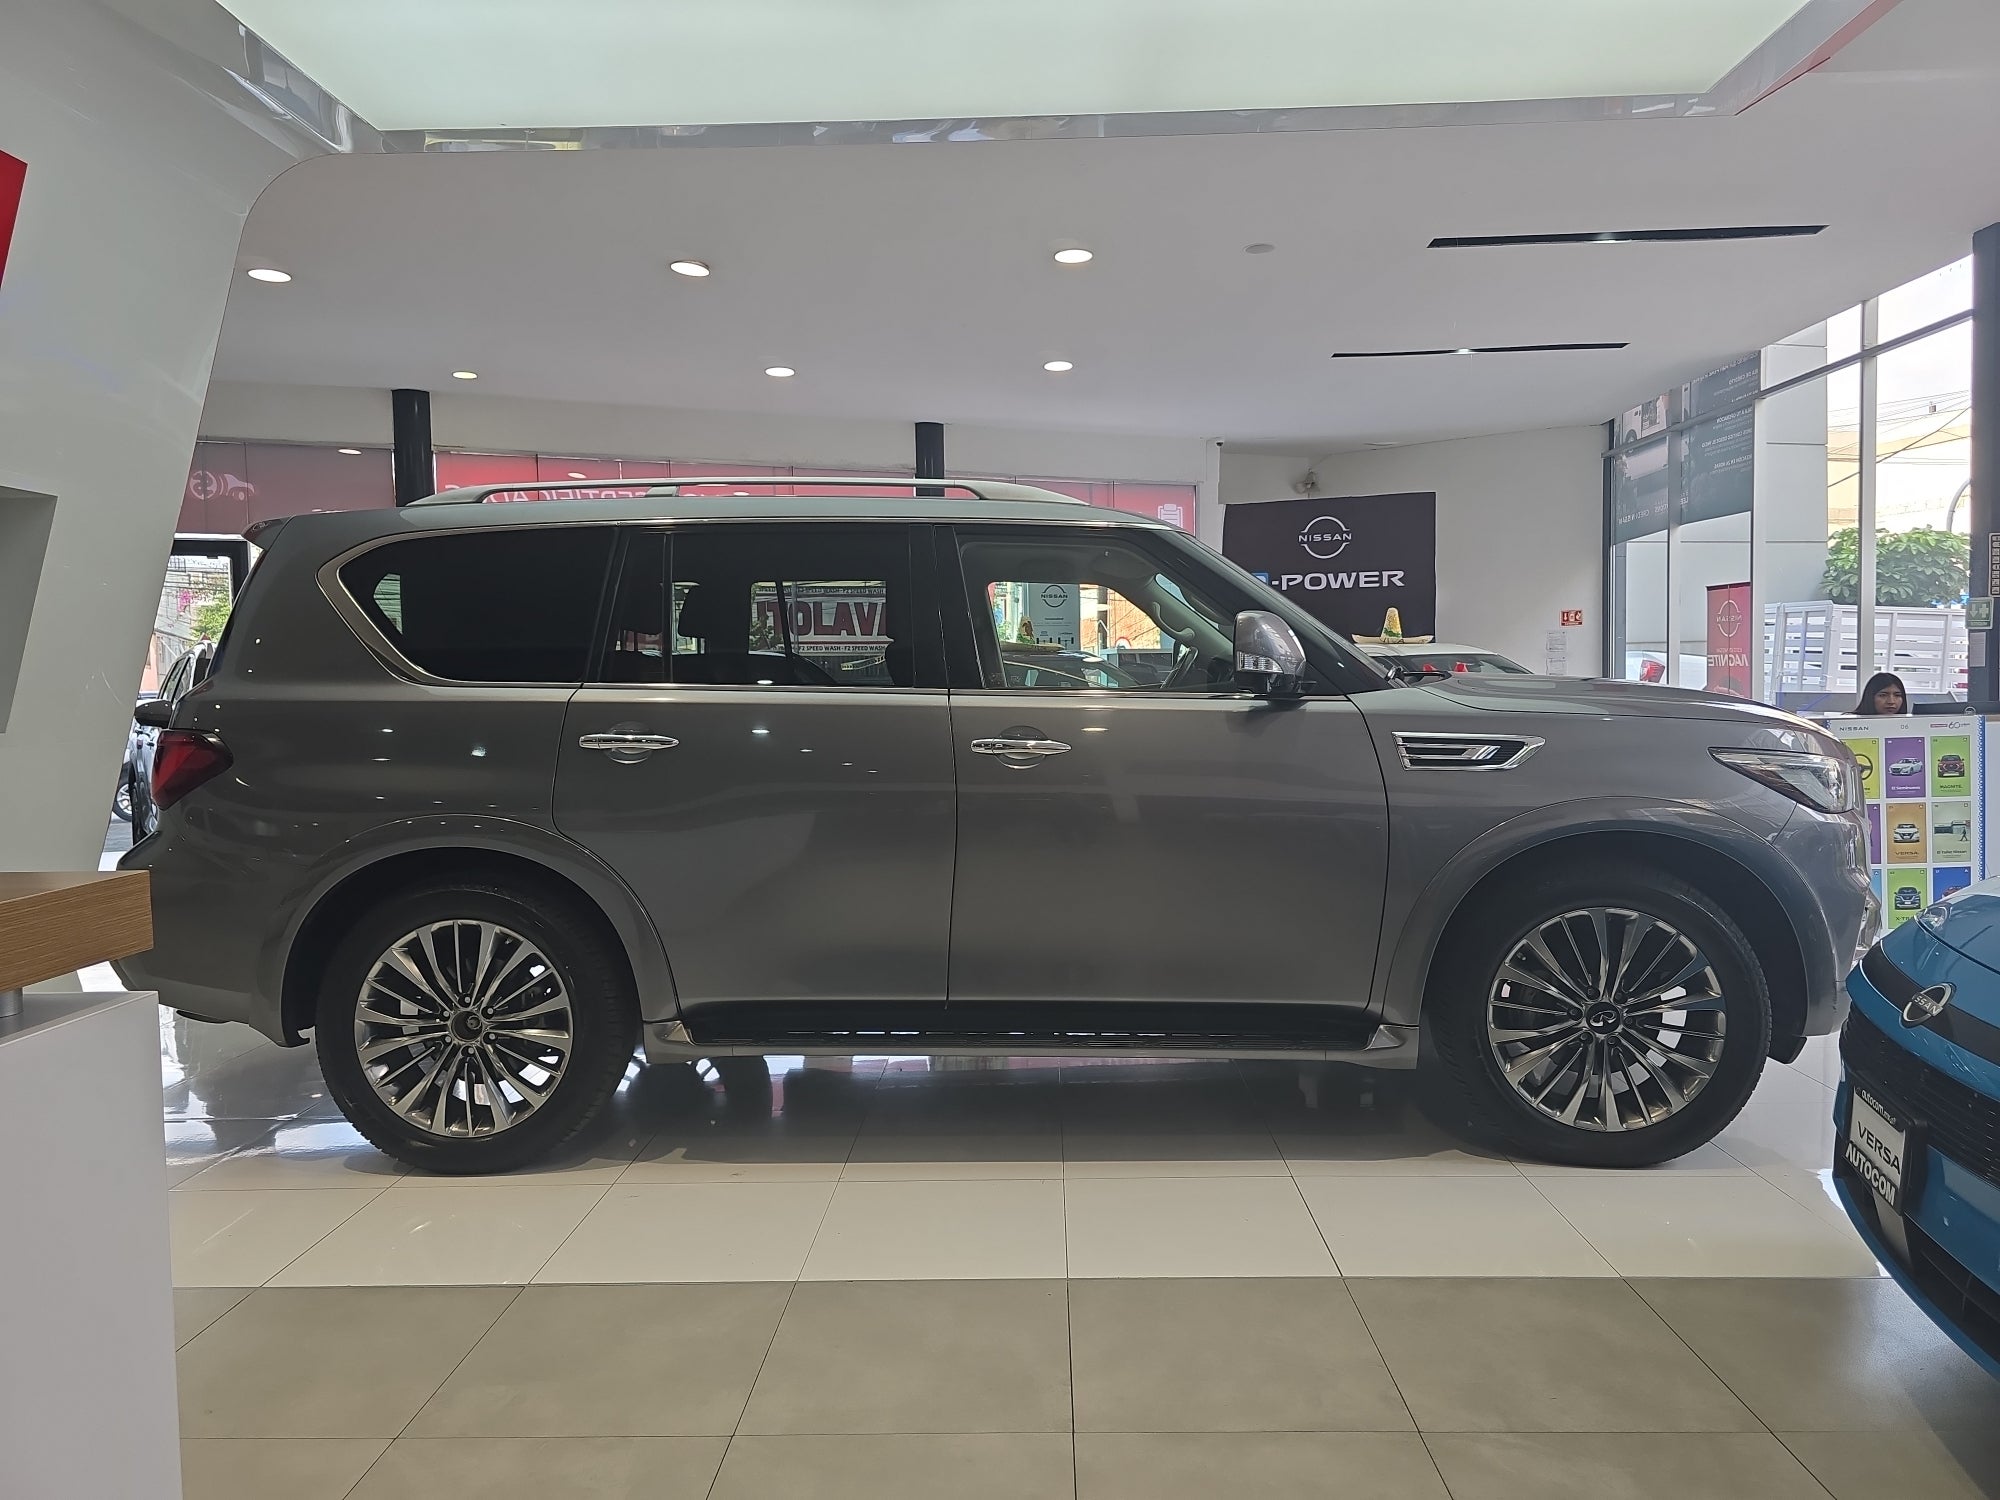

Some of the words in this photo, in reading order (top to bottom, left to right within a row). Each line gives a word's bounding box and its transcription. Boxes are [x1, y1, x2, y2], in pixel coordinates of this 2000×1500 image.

[1298, 532, 1352, 543] NISSAN
[1845, 1142, 1896, 1206] AUTOCOM
[1858, 1120, 1901, 1175] VERSA
